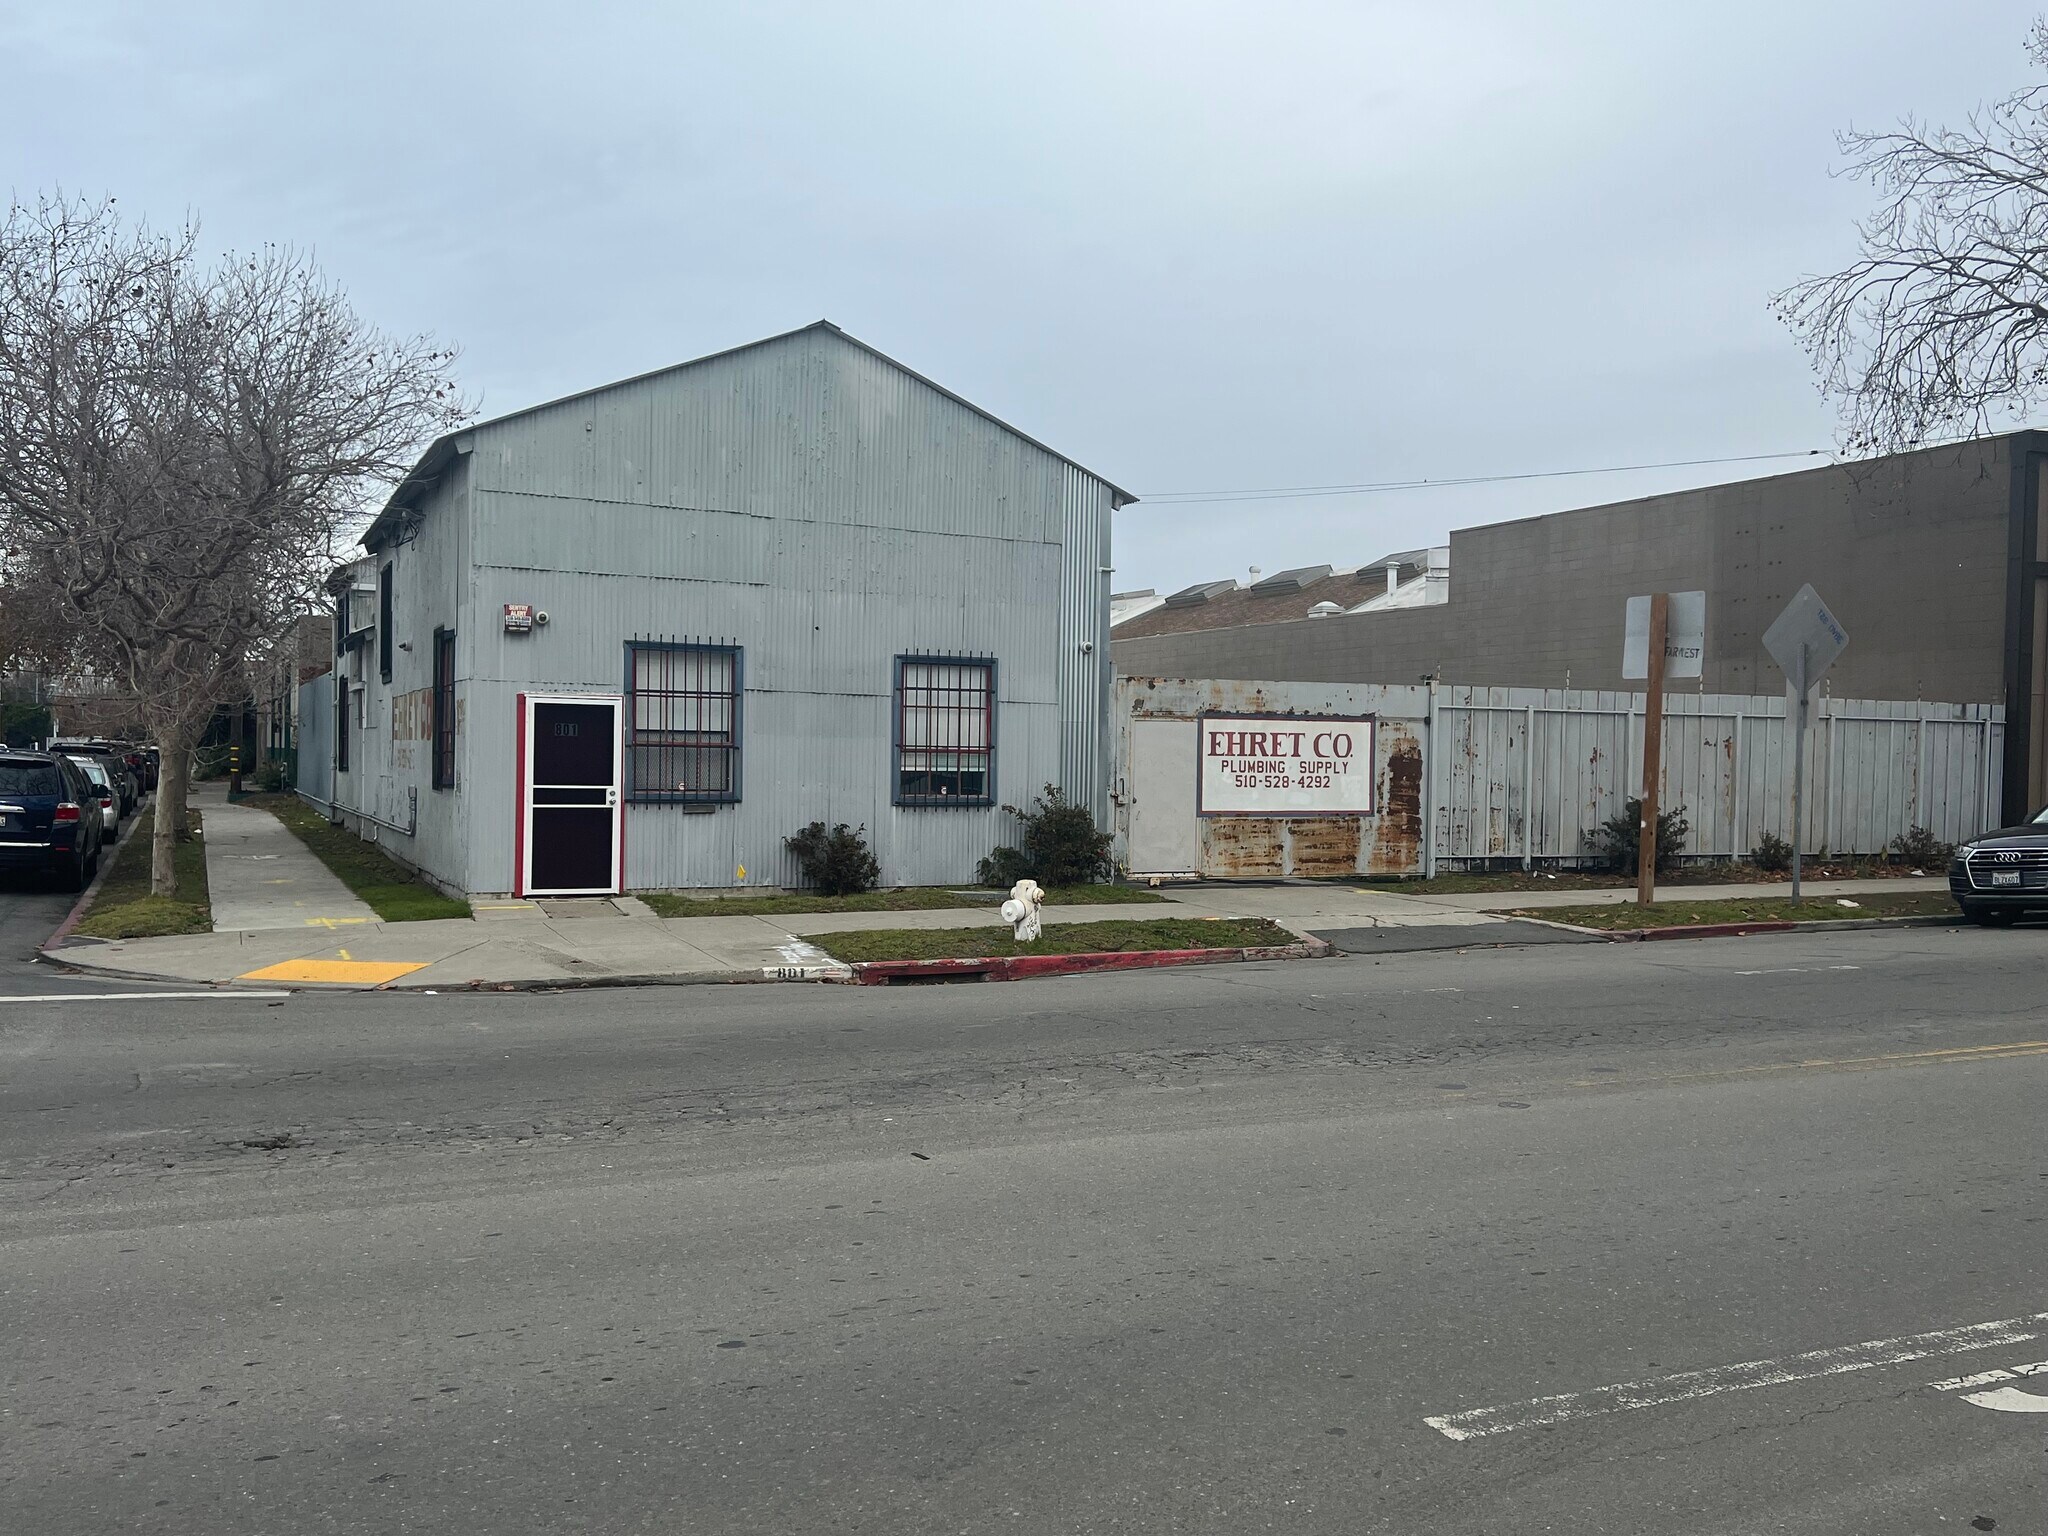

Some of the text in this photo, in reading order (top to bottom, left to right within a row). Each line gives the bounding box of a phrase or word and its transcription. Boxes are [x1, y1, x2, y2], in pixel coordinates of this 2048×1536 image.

[555, 723, 578, 737] 801
[1208, 730, 1354, 759] EHRET CO.
[1221, 759, 1349, 775] PLUMBING SUPPLY
[1235, 774, 1331, 789] 510-528-4292
